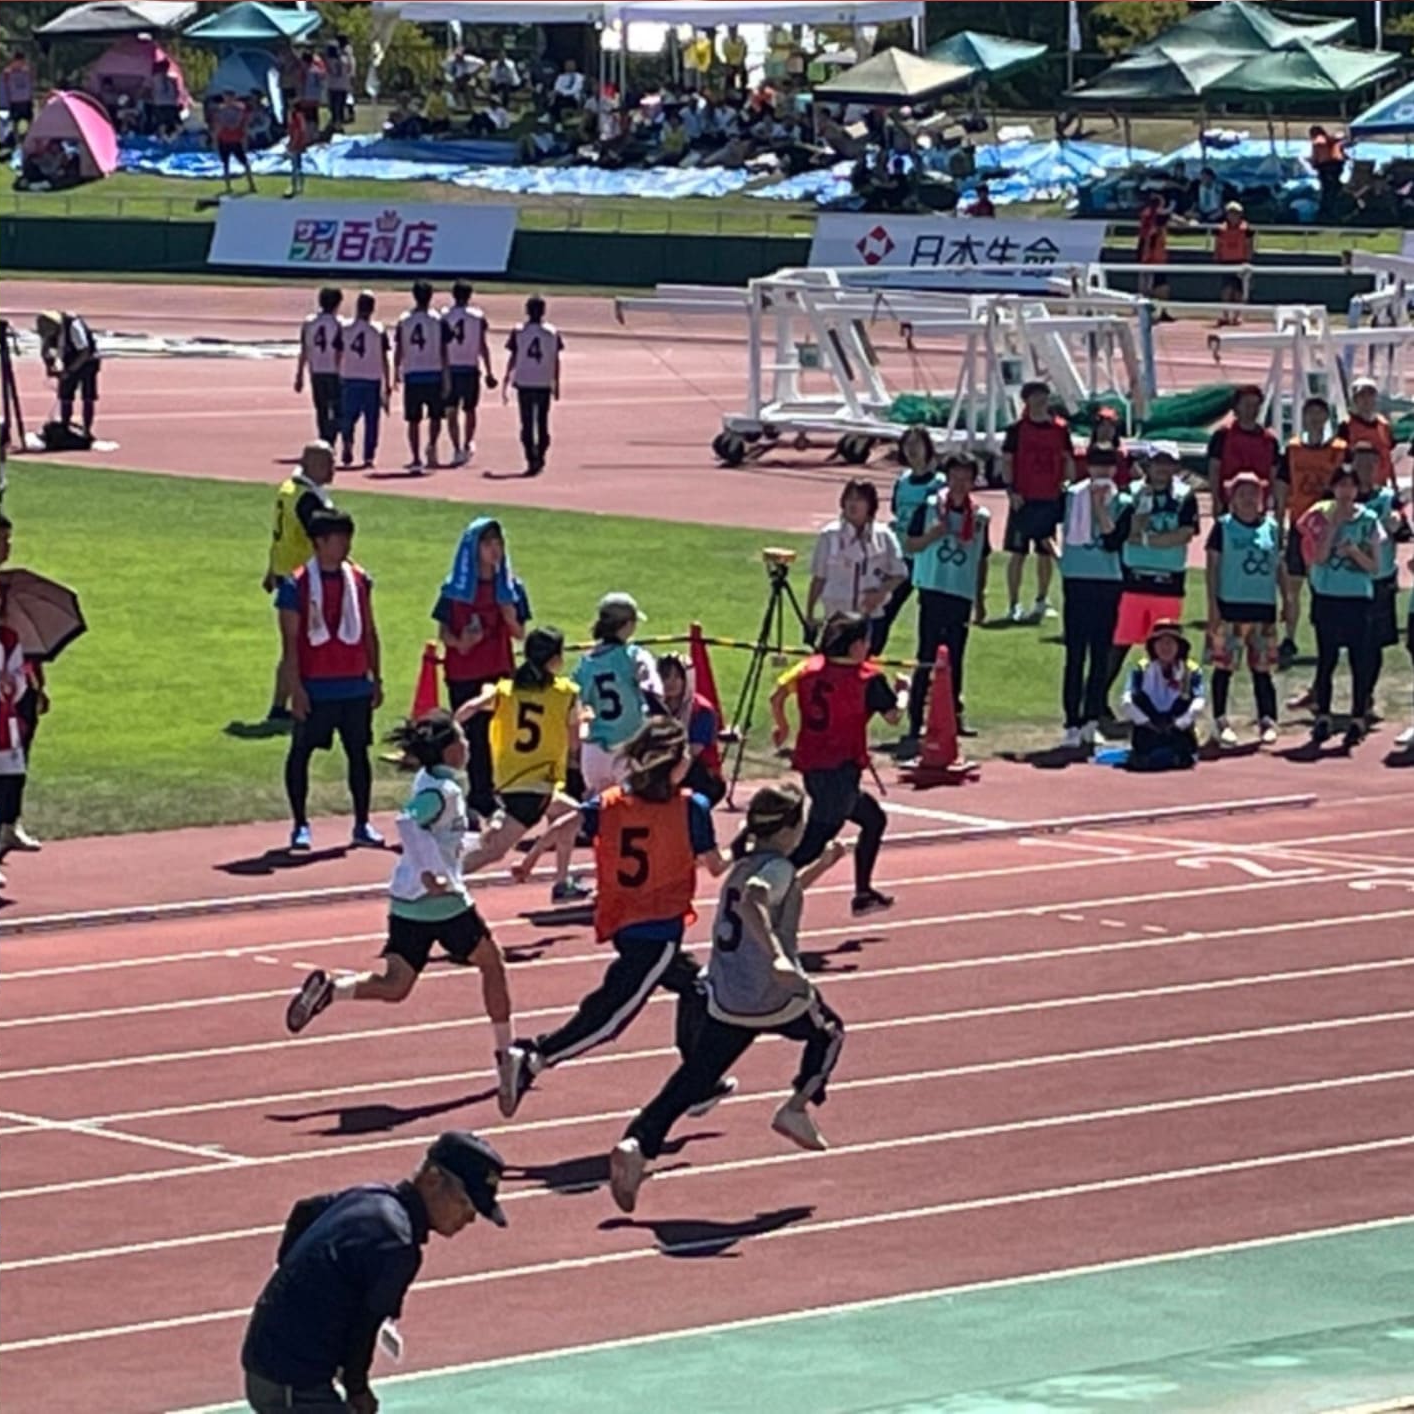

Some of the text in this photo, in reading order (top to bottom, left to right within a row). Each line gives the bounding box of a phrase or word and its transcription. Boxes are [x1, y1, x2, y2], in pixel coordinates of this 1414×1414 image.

[909, 234, 1061, 277] 日本生命
[313, 324, 328, 354] 4
[350, 332, 367, 358] 4
[409, 322, 426, 351] 4
[453, 318, 467, 346] 4
[527, 336, 544, 363] 4
[593, 671, 623, 721] 5
[806, 678, 835, 731] 5
[513, 701, 545, 754] 5
[617, 826, 650, 887] 5
[716, 888, 744, 952] 5
